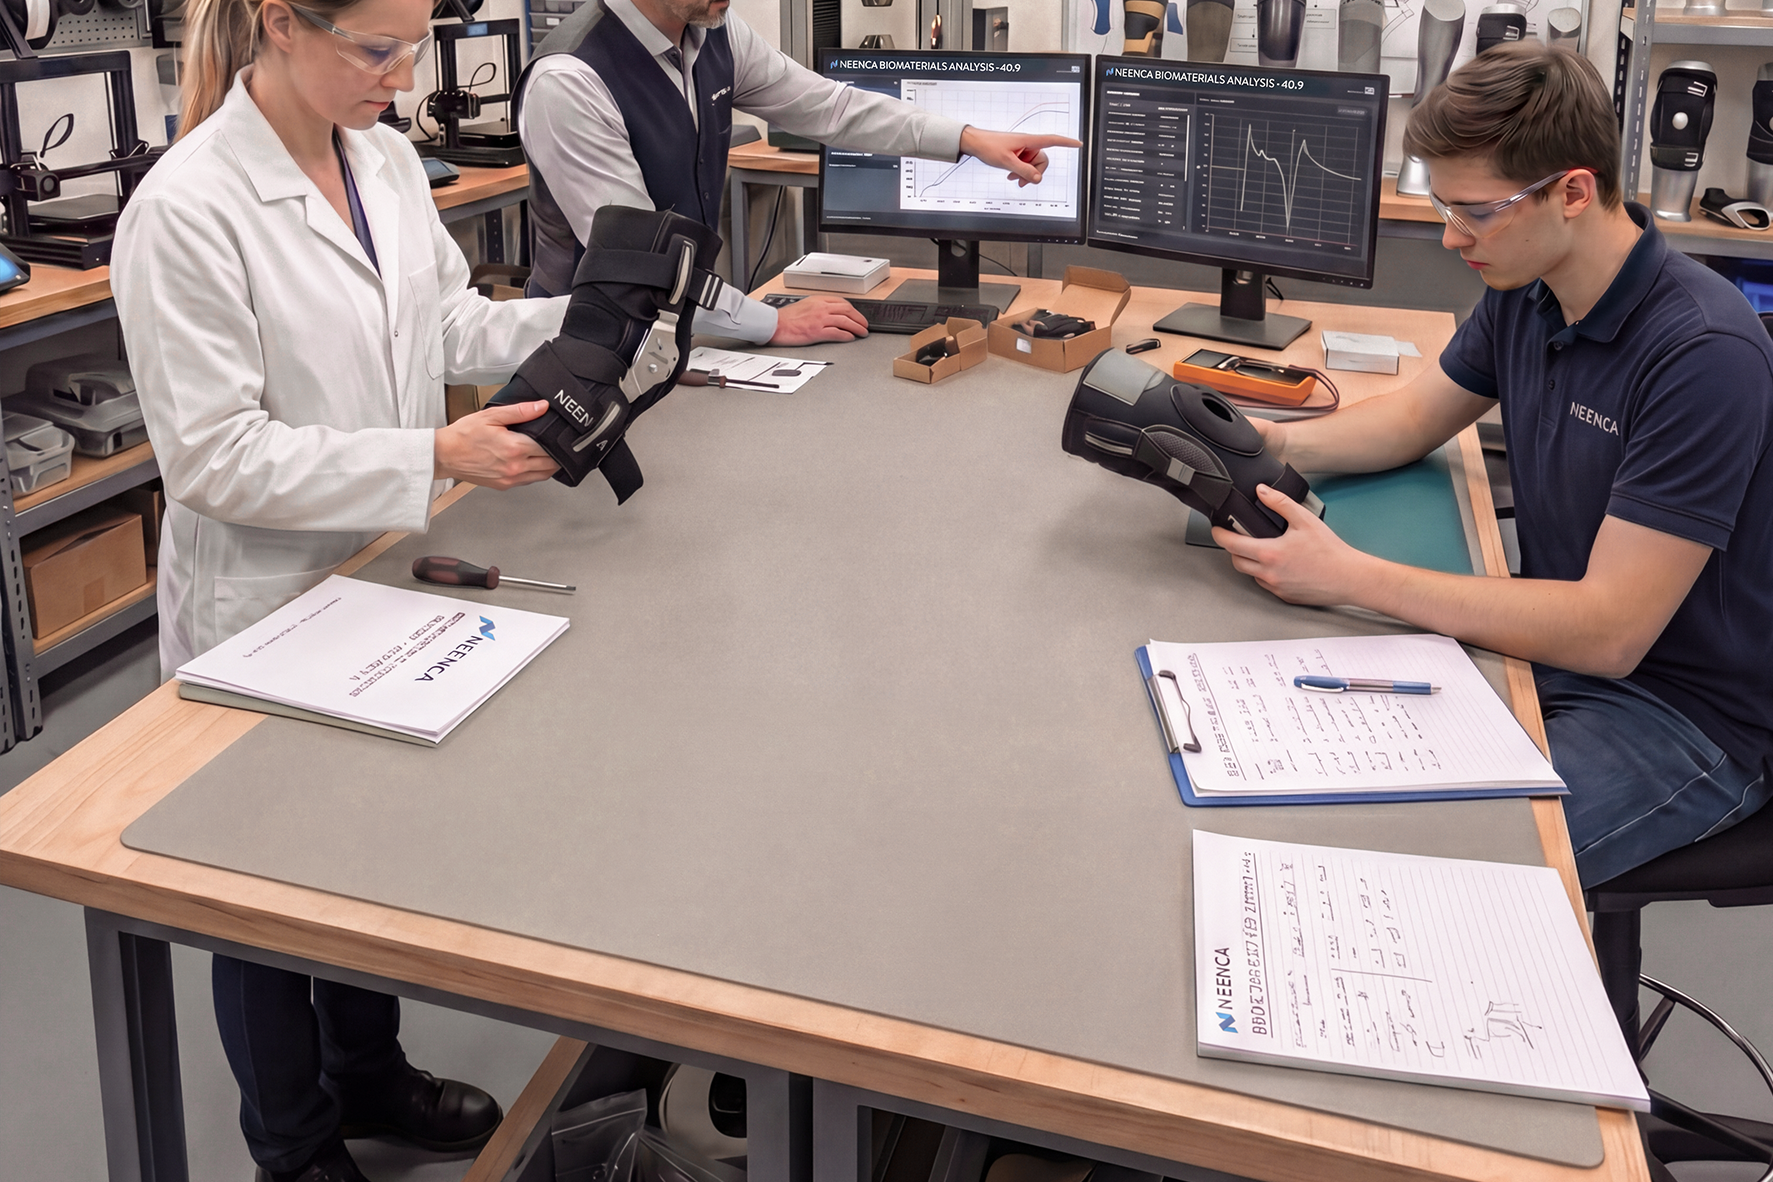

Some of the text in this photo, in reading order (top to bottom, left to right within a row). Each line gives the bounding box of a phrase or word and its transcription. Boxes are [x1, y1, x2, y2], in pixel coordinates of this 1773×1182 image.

[839, 59, 879, 70] NEENCA
[879, 60, 948, 71] BIOMATERIALS
[948, 62, 995, 72] ANALYSIS
[1114, 67, 1154, 79] NEENCA
[1154, 70, 1226, 85] BIOMATERIALS
[1226, 75, 1275, 89] ANALYSIS
[1569, 401, 1620, 436] NEENCA
[414, 635, 484, 682] NEENCA
[1214, 946, 1233, 1010] NEENCA
